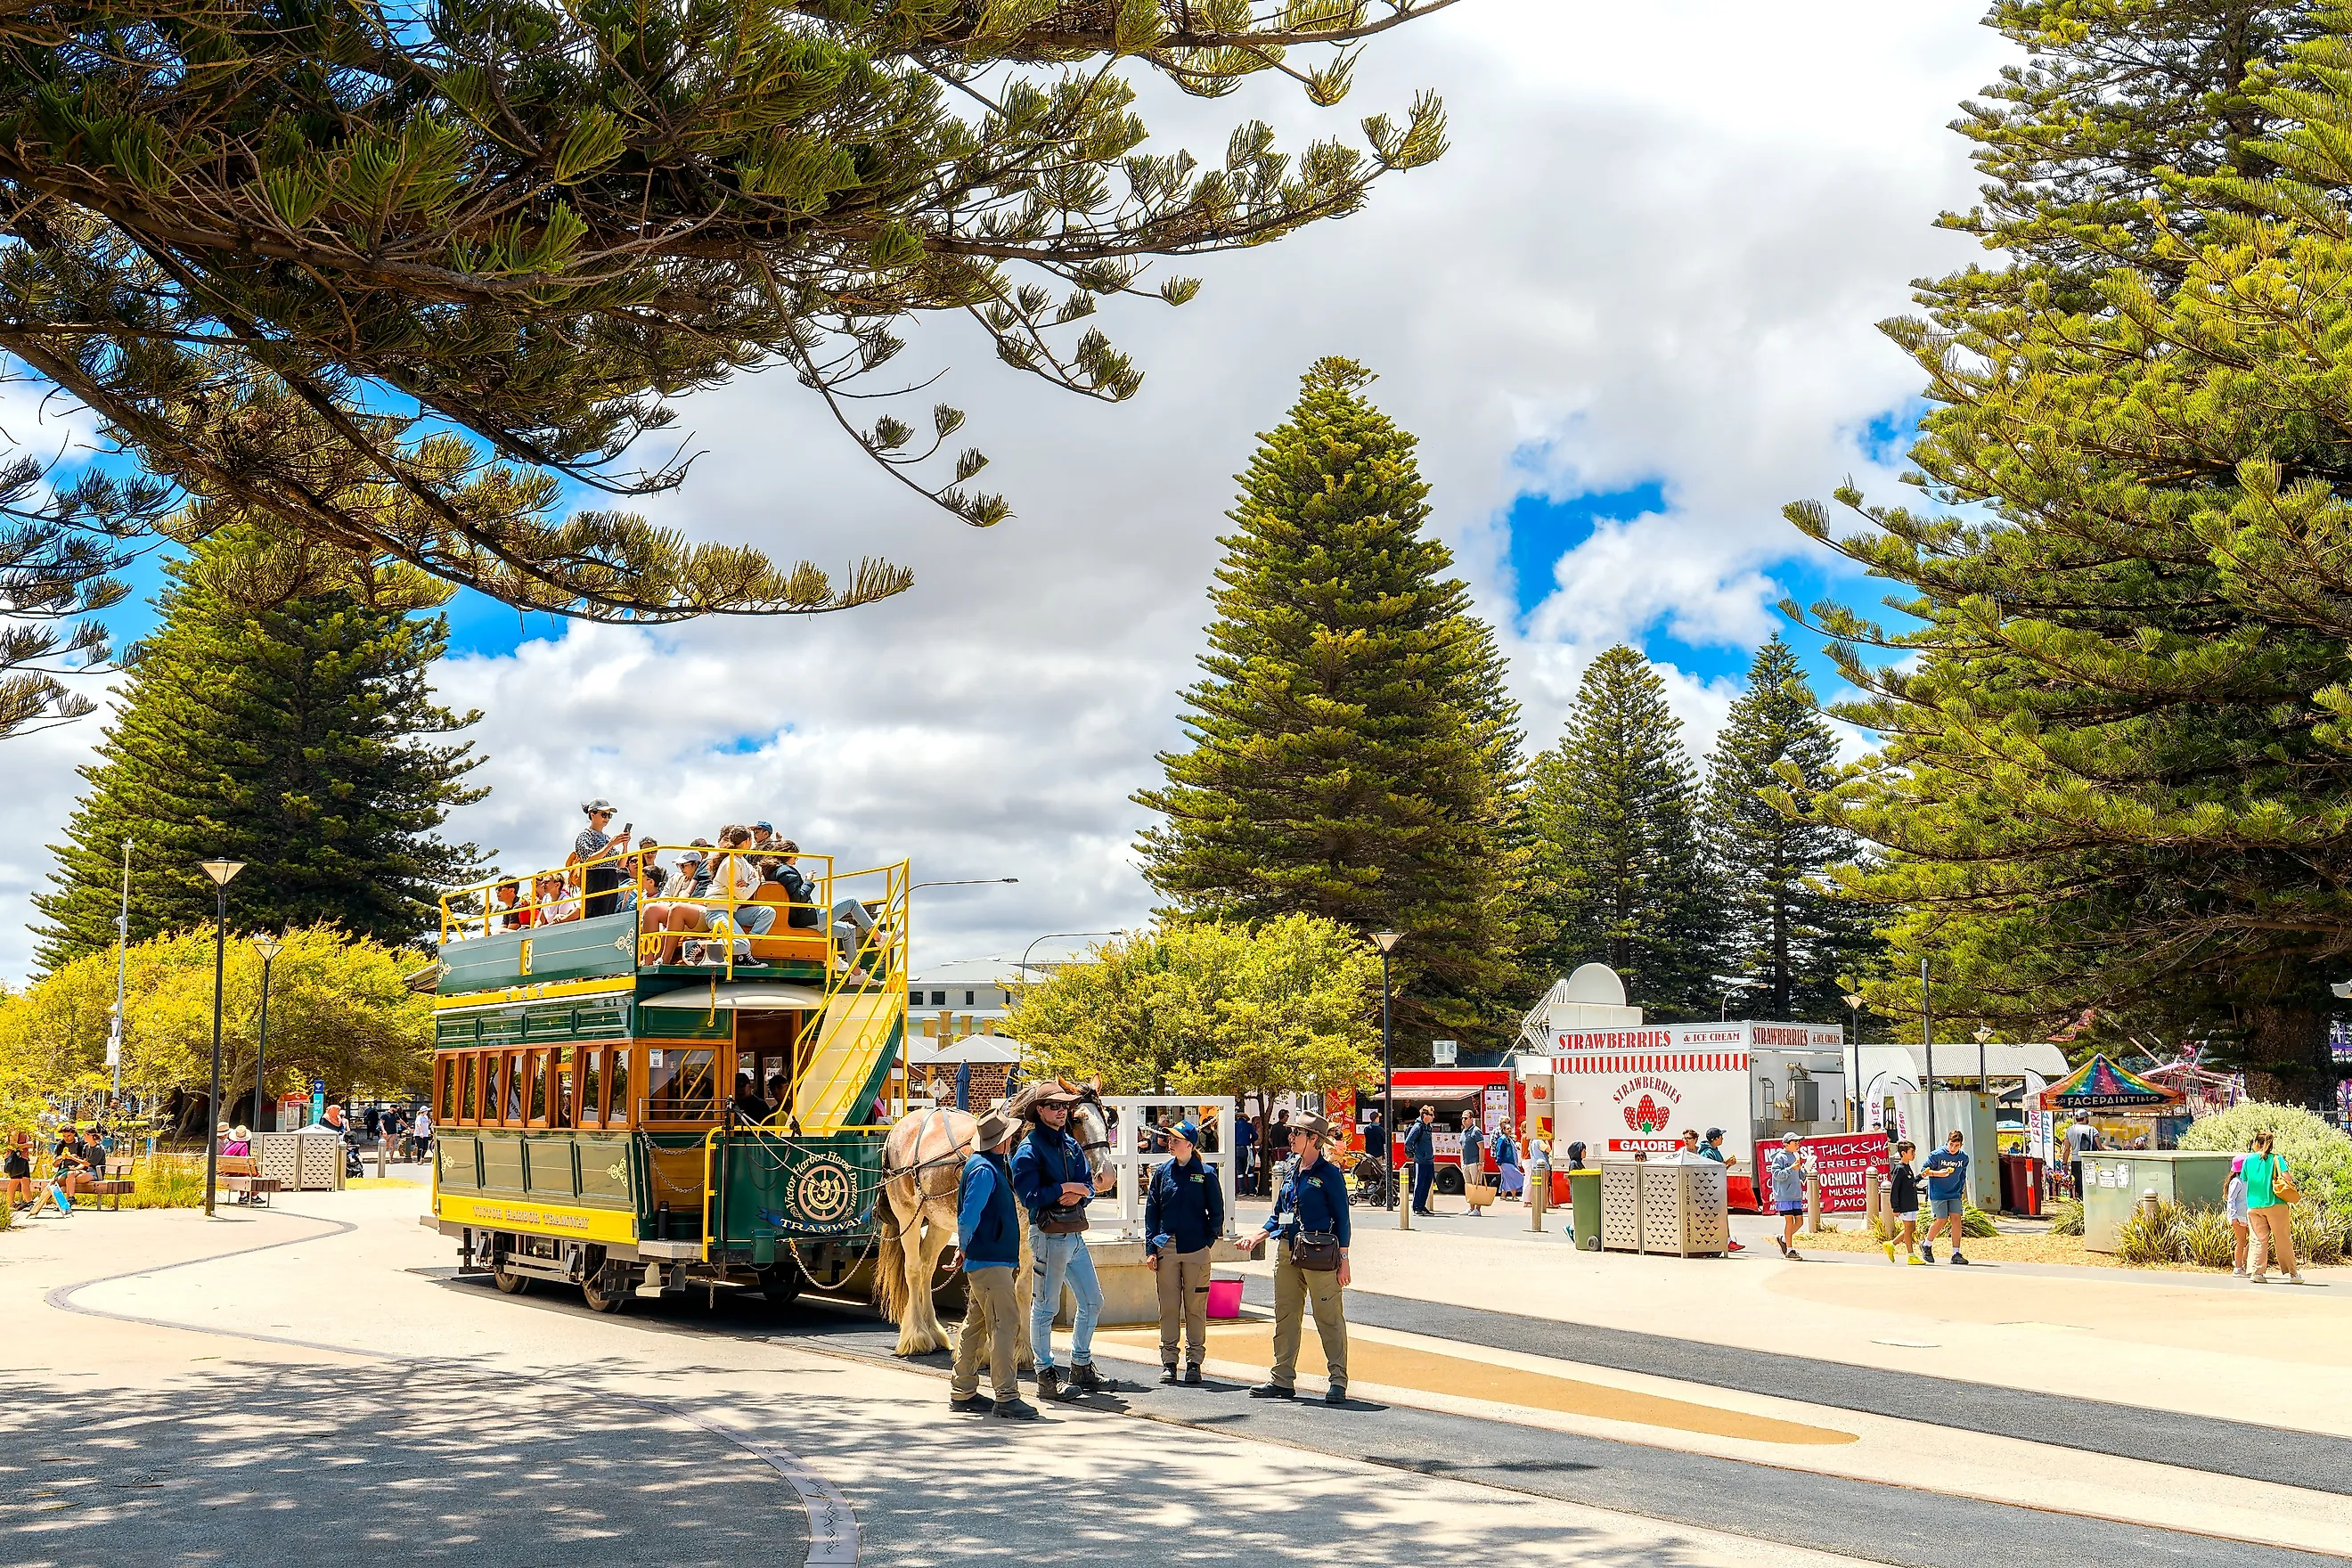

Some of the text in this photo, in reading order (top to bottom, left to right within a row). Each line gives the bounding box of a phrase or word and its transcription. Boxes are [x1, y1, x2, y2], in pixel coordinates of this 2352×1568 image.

[1558, 1030, 1740, 1050] STRAWBERRIES & ICE CREAM
[1752, 1026, 1809, 1047] STRAWBERRIES
[1817, 1033, 1825, 1043] ICE
[1825, 1034, 1840, 1044] CREAM
[1613, 1075, 1682, 1105] STRAWBERRIES
[1620, 1139, 1676, 1151] GALORE
[784, 1175, 797, 1209] Victor
[792, 1152, 827, 1174] Harbor
[816, 1179, 831, 1201] 3
[473, 1205, 590, 1229] VICTOR HARBOR TRAMWAY
[780, 1214, 864, 1233] TRAMWAY
